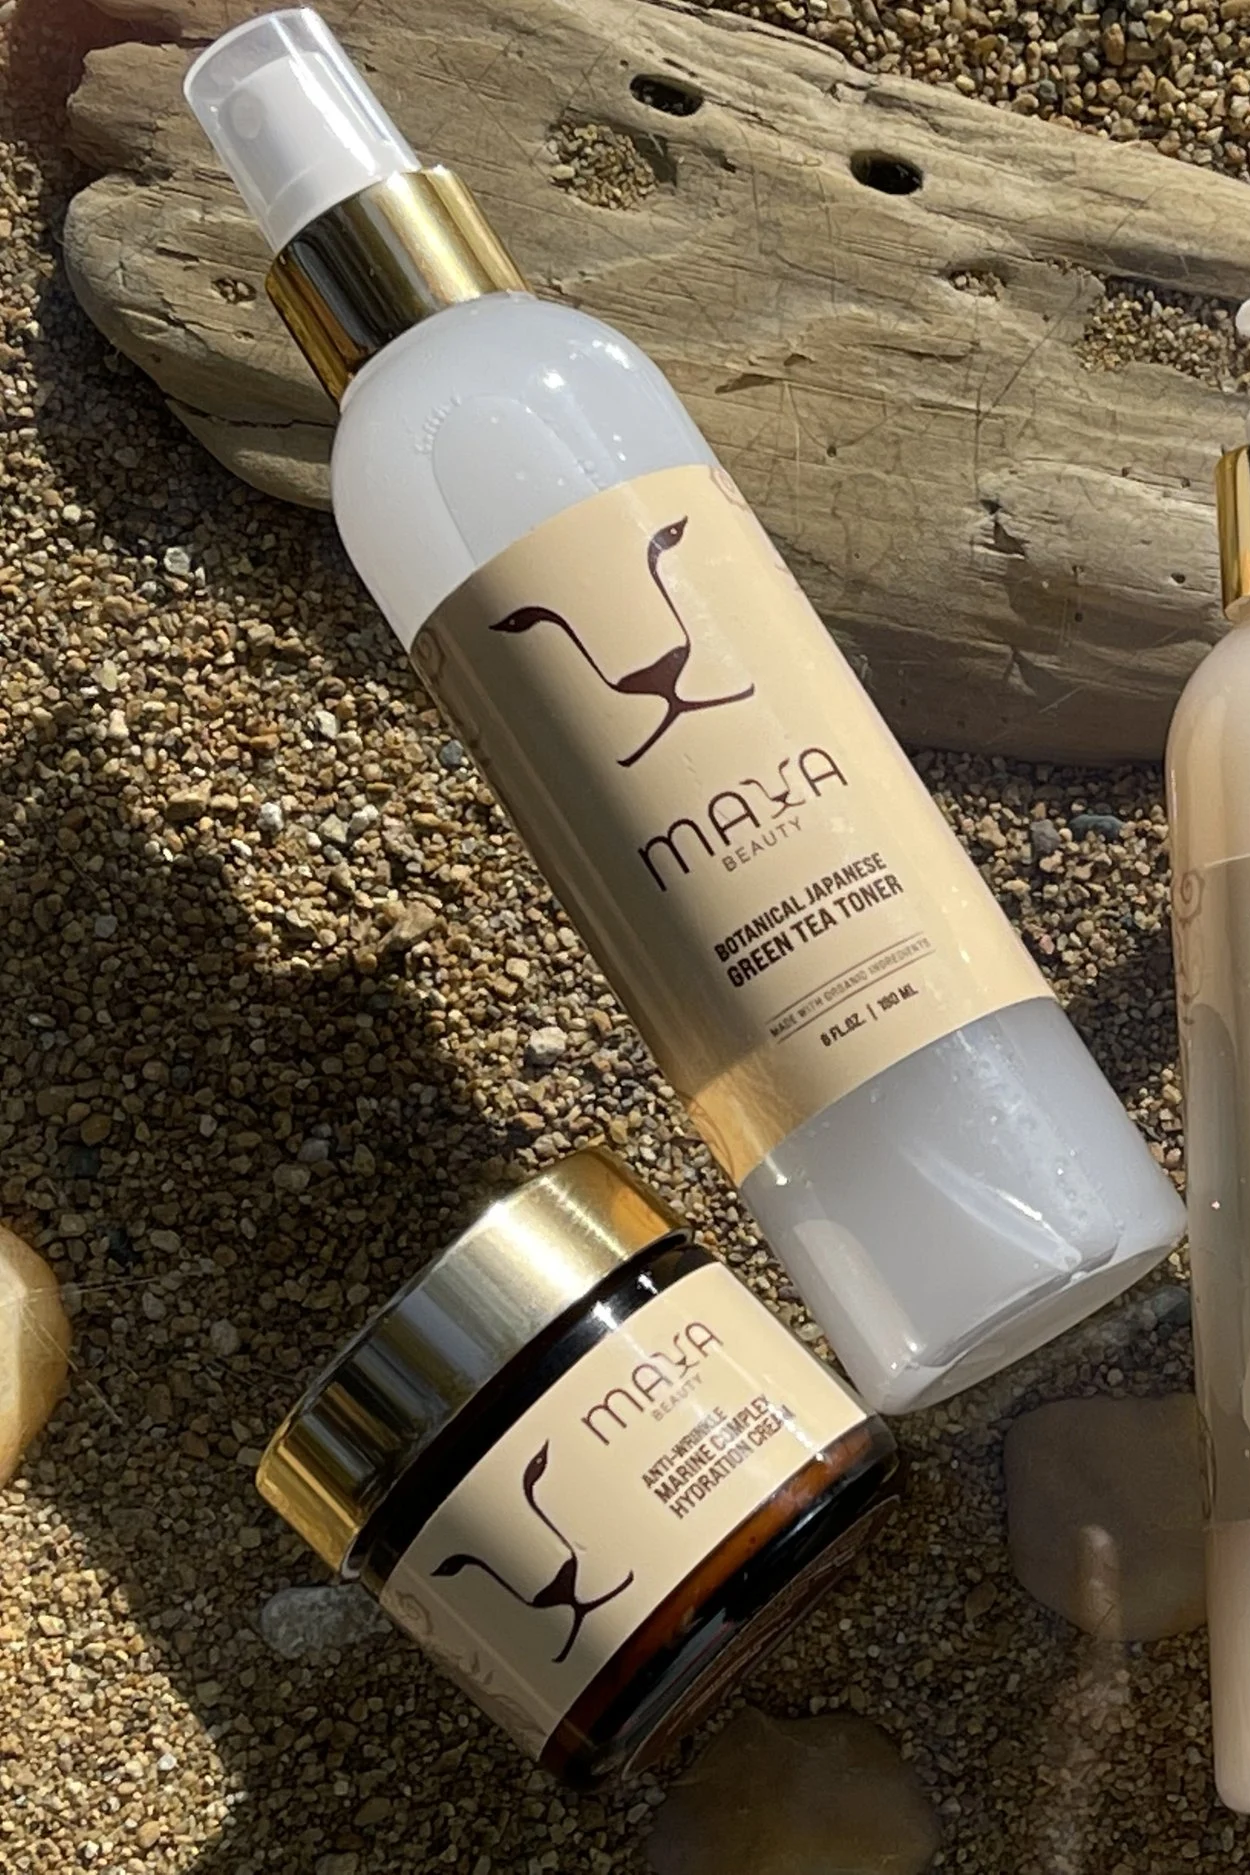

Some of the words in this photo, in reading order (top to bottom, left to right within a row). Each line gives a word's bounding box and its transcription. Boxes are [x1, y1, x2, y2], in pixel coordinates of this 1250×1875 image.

[721, 815, 802, 873] BEAUTY
[714, 896, 805, 963] BOTANICAL
[804, 852, 887, 905] JAPANESE
[727, 931, 794, 988] GREEN
[790, 911, 837, 943] TEA
[834, 873, 904, 921] TONER
[769, 1014, 798, 1038] MADE
[797, 998, 823, 1023] WITH
[823, 970, 868, 1002] ORGANIC
[867, 937, 932, 976] INGREDIENTS
[899, 983, 920, 1004] ML
[651, 1373, 703, 1422] BEAUTY
[641, 1406, 728, 1489] ANTI-WRINKLE
[654, 1444, 716, 1504] MARINE
[669, 1440, 755, 1519] HYDRATION
